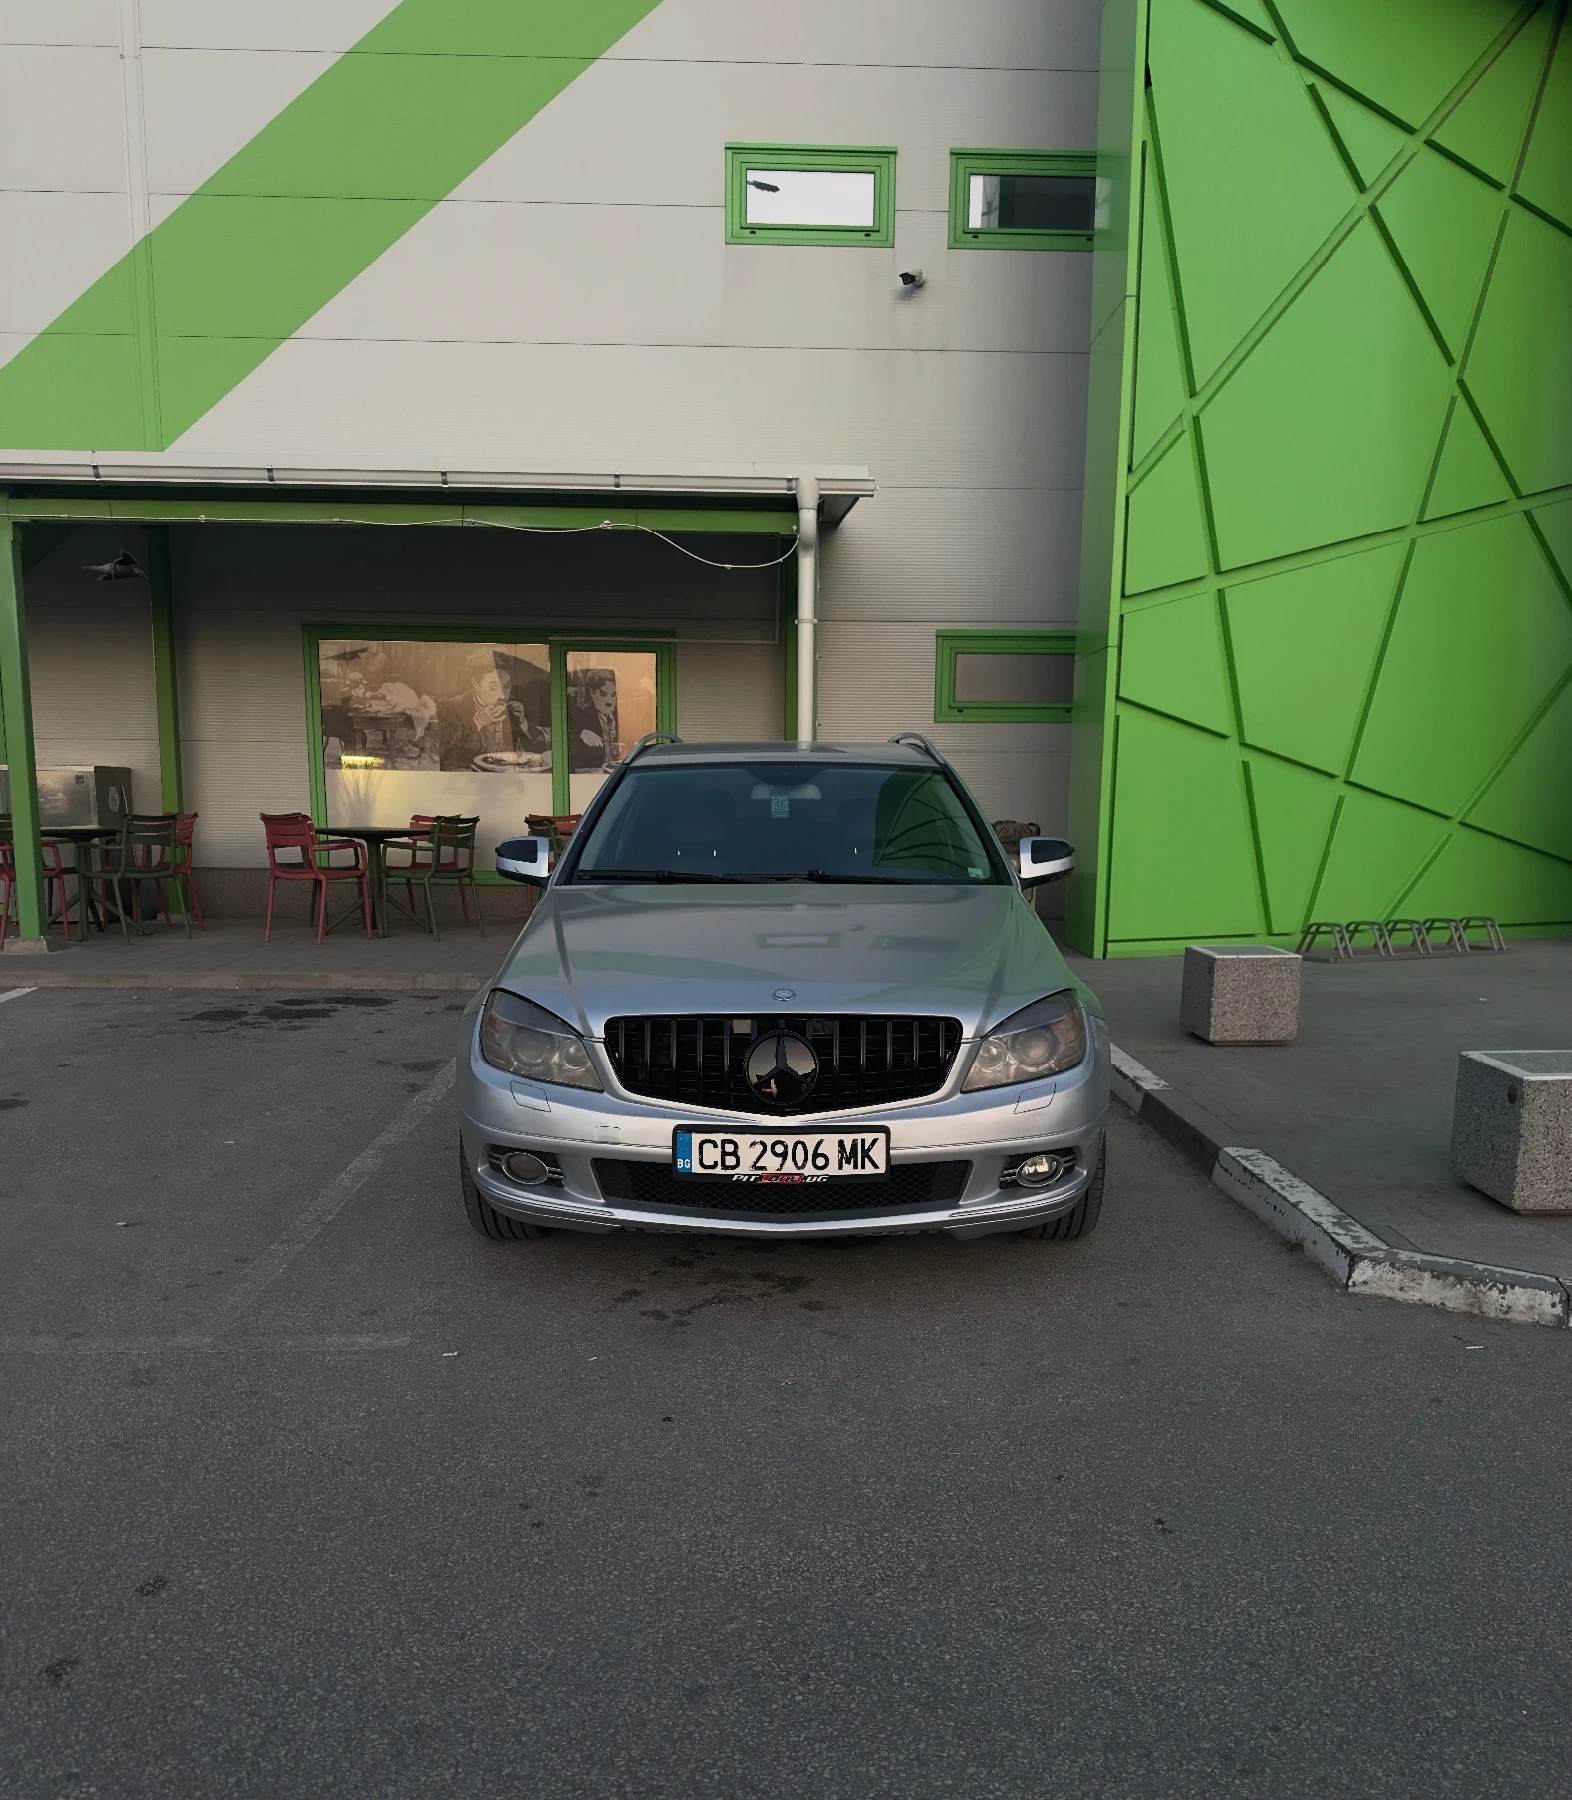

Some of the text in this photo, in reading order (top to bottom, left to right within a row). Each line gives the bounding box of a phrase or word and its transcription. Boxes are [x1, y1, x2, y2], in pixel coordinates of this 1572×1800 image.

[677, 1158, 691, 1169] BG
[698, 1137, 880, 1171] CB 2906 MK
